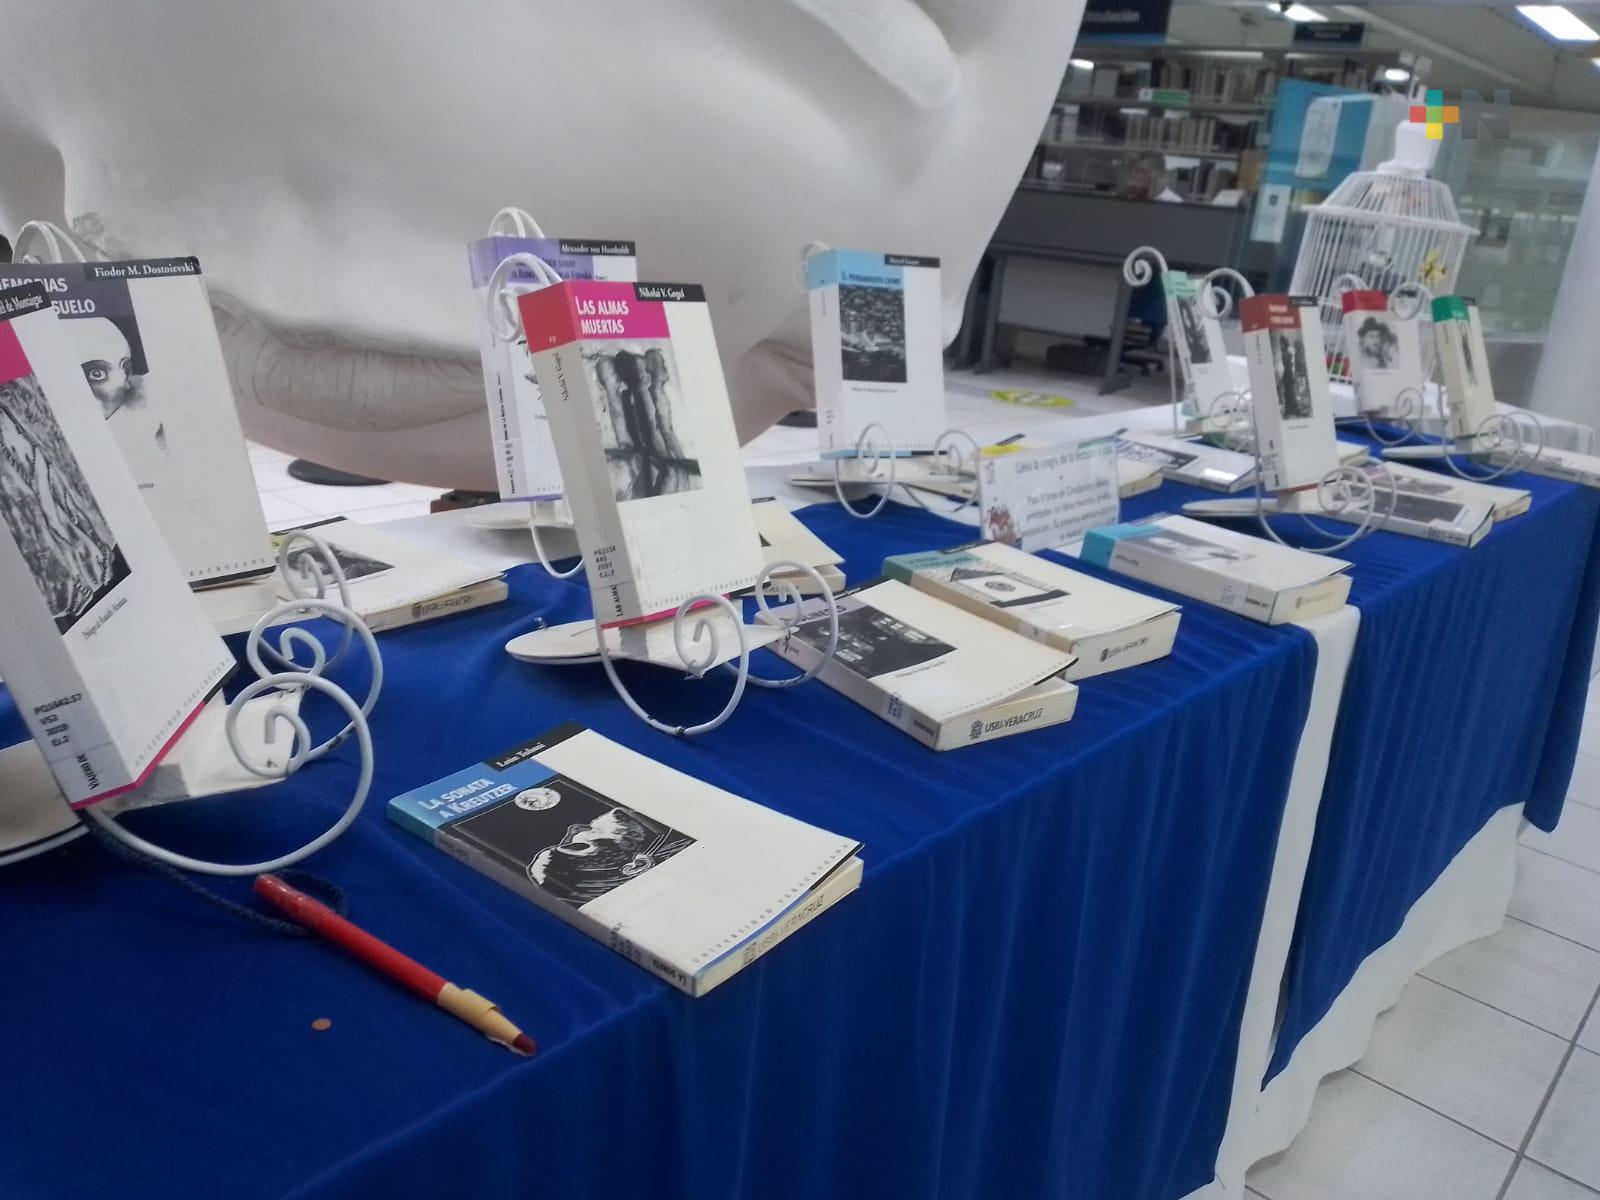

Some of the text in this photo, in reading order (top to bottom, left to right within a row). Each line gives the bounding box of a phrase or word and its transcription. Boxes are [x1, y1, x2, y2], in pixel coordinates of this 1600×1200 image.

[94, 265, 125, 278] Fiodor
[127, 264, 141, 276] M.
[0, 277, 69, 293] EMIAS
[575, 296, 629, 316] LAS ALMAS
[581, 318, 625, 335] MUERTAS
[418, 778, 495, 810] LA SONATA
[438, 782, 519, 819] A KREUTZER
